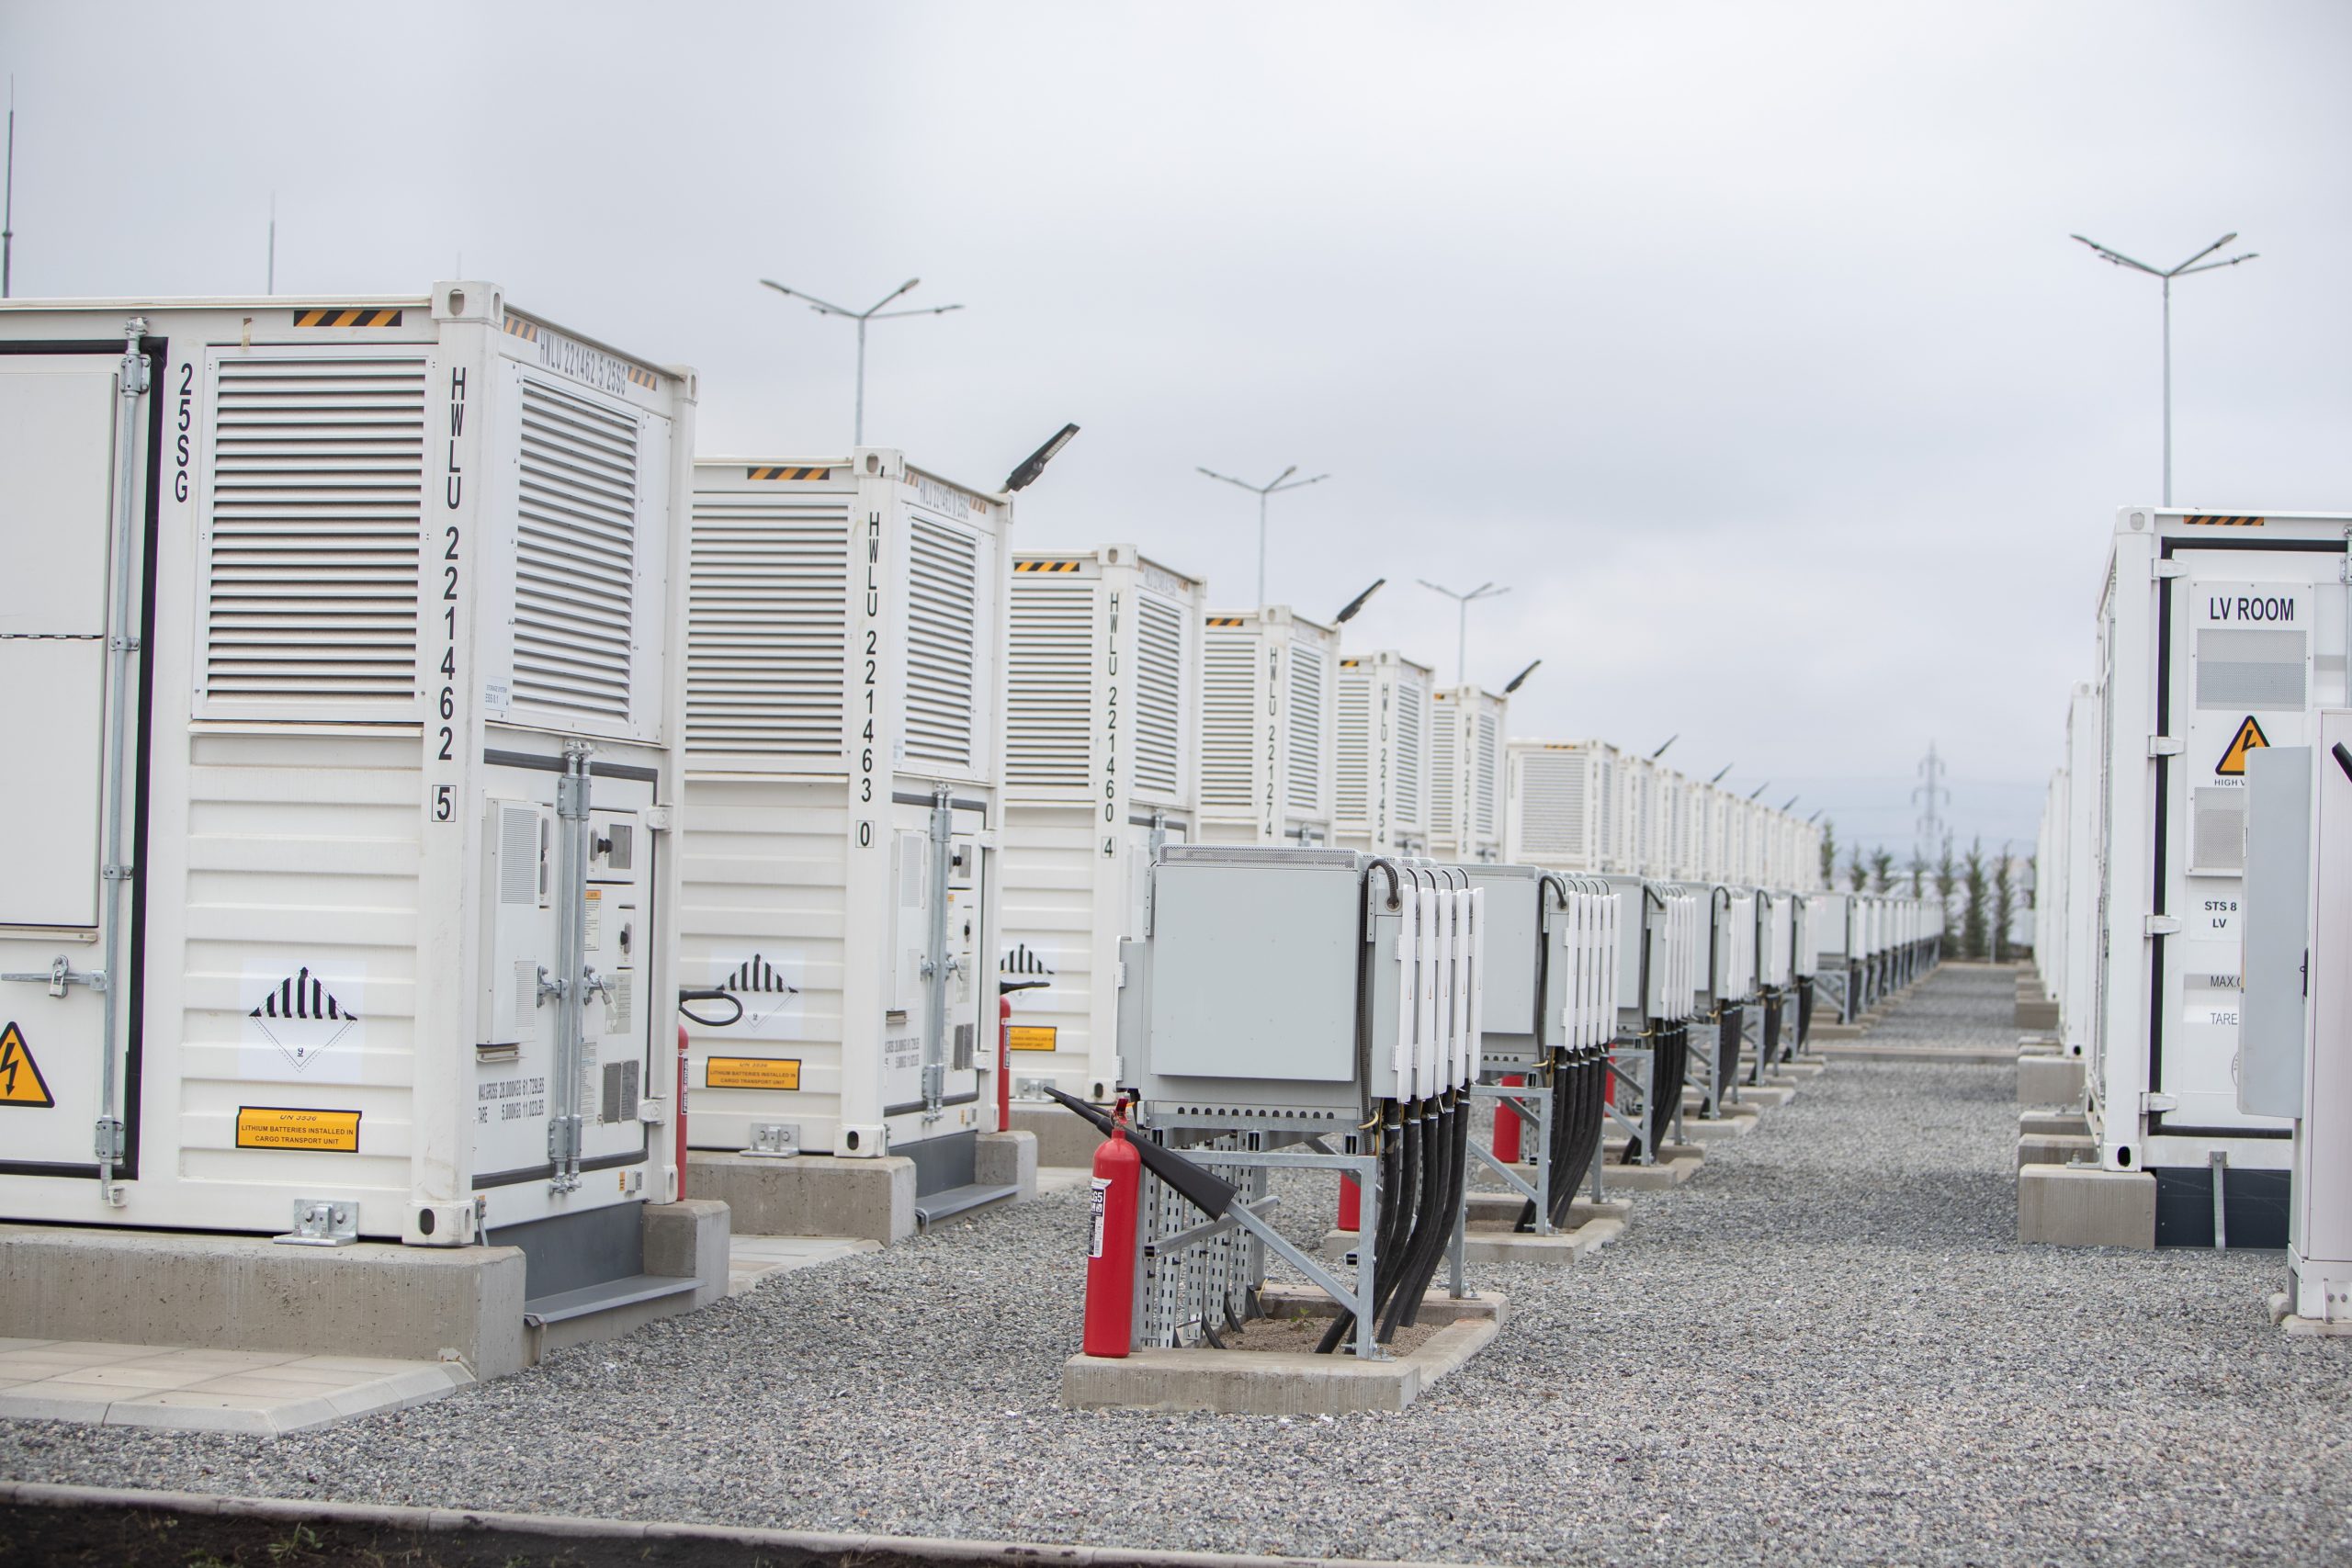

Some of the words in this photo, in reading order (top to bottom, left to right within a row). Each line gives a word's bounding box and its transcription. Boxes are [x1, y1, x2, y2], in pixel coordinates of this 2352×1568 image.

[539, 330, 562, 370] HWLU
[564, 342, 595, 384] 221462
[175, 363, 193, 503] 25SG
[447, 367, 467, 510] HWLU
[866, 512, 879, 617] HWLU
[1108, 592, 1119, 676] HWLU
[2210, 597, 2232, 620] LV
[2237, 597, 2294, 621] ROOM
[438, 526, 459, 761] 221462
[1269, 647, 1278, 716] HWLU
[861, 630, 876, 803] 221463
[1104, 686, 1117, 822] 221460
[1265, 725, 1275, 838] 221274
[436, 786, 451, 820] 5
[860, 822, 870, 847] 0
[1103, 837, 1113, 858] 4
[2204, 901, 2227, 911] STS
[2230, 901, 2237, 911] 8
[2212, 919, 2227, 928] LV
[2210, 1012, 2238, 1025] TARE
[297, 1047, 304, 1056] 9
